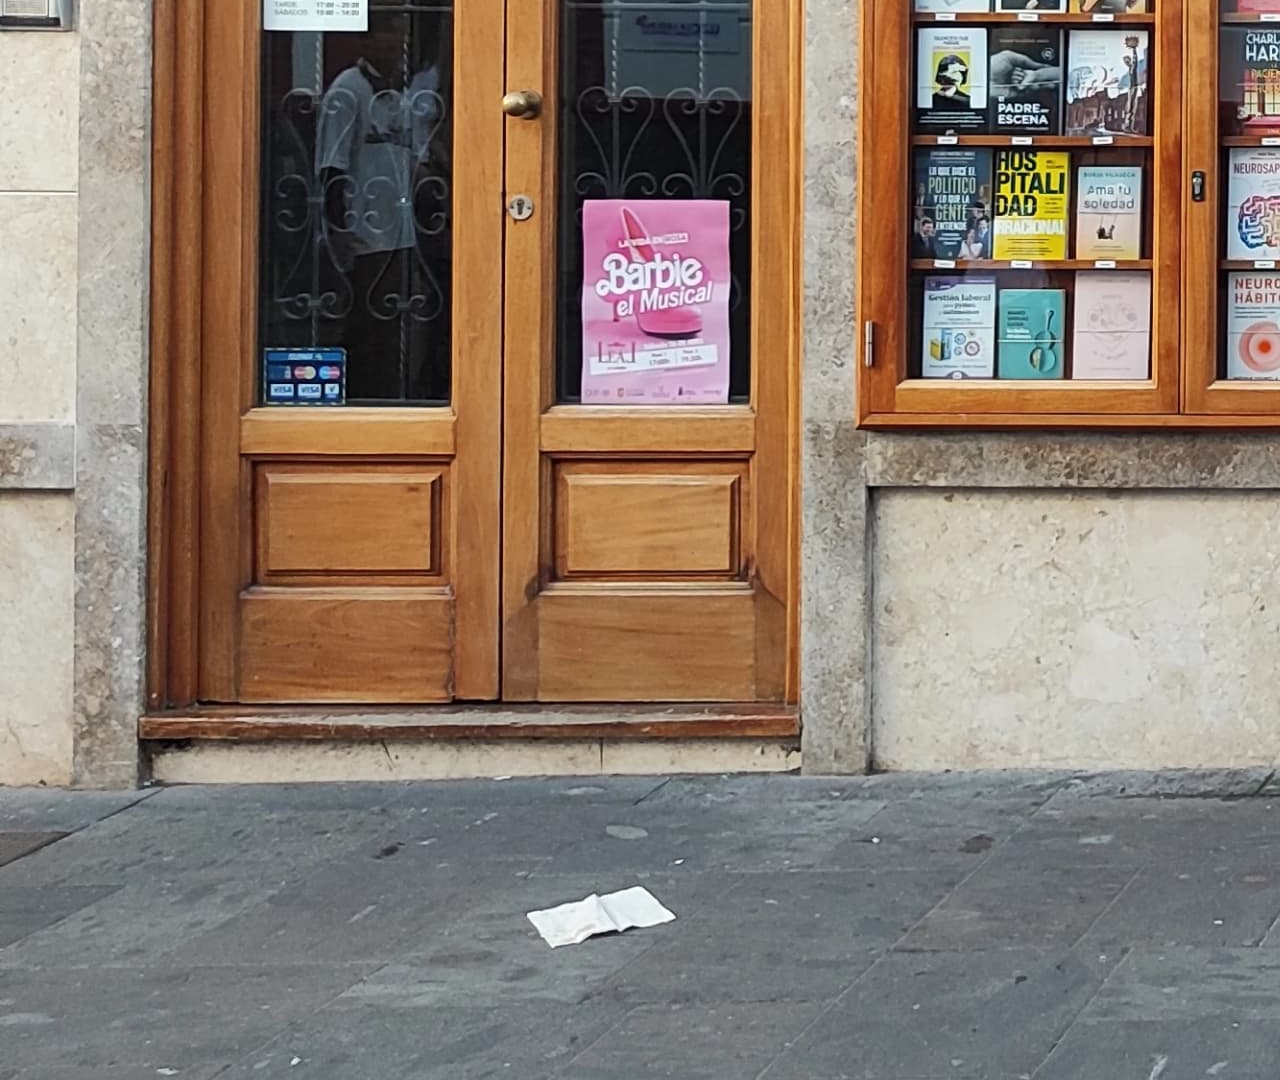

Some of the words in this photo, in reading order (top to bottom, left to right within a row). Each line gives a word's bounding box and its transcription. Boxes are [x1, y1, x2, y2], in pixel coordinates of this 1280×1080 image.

[998, 103, 1041, 113] PADRE
[998, 114, 1048, 125] ESCENA
[1087, 185, 1115, 195] Ama
[1118, 186, 1131, 195] tu
[995, 195, 1037, 216] DAD
[1084, 197, 1135, 209] soledad
[935, 204, 967, 221] GENTE
[595, 252, 704, 296] Barbie
[616, 299, 634, 316] el
[640, 281, 713, 312] Musical
